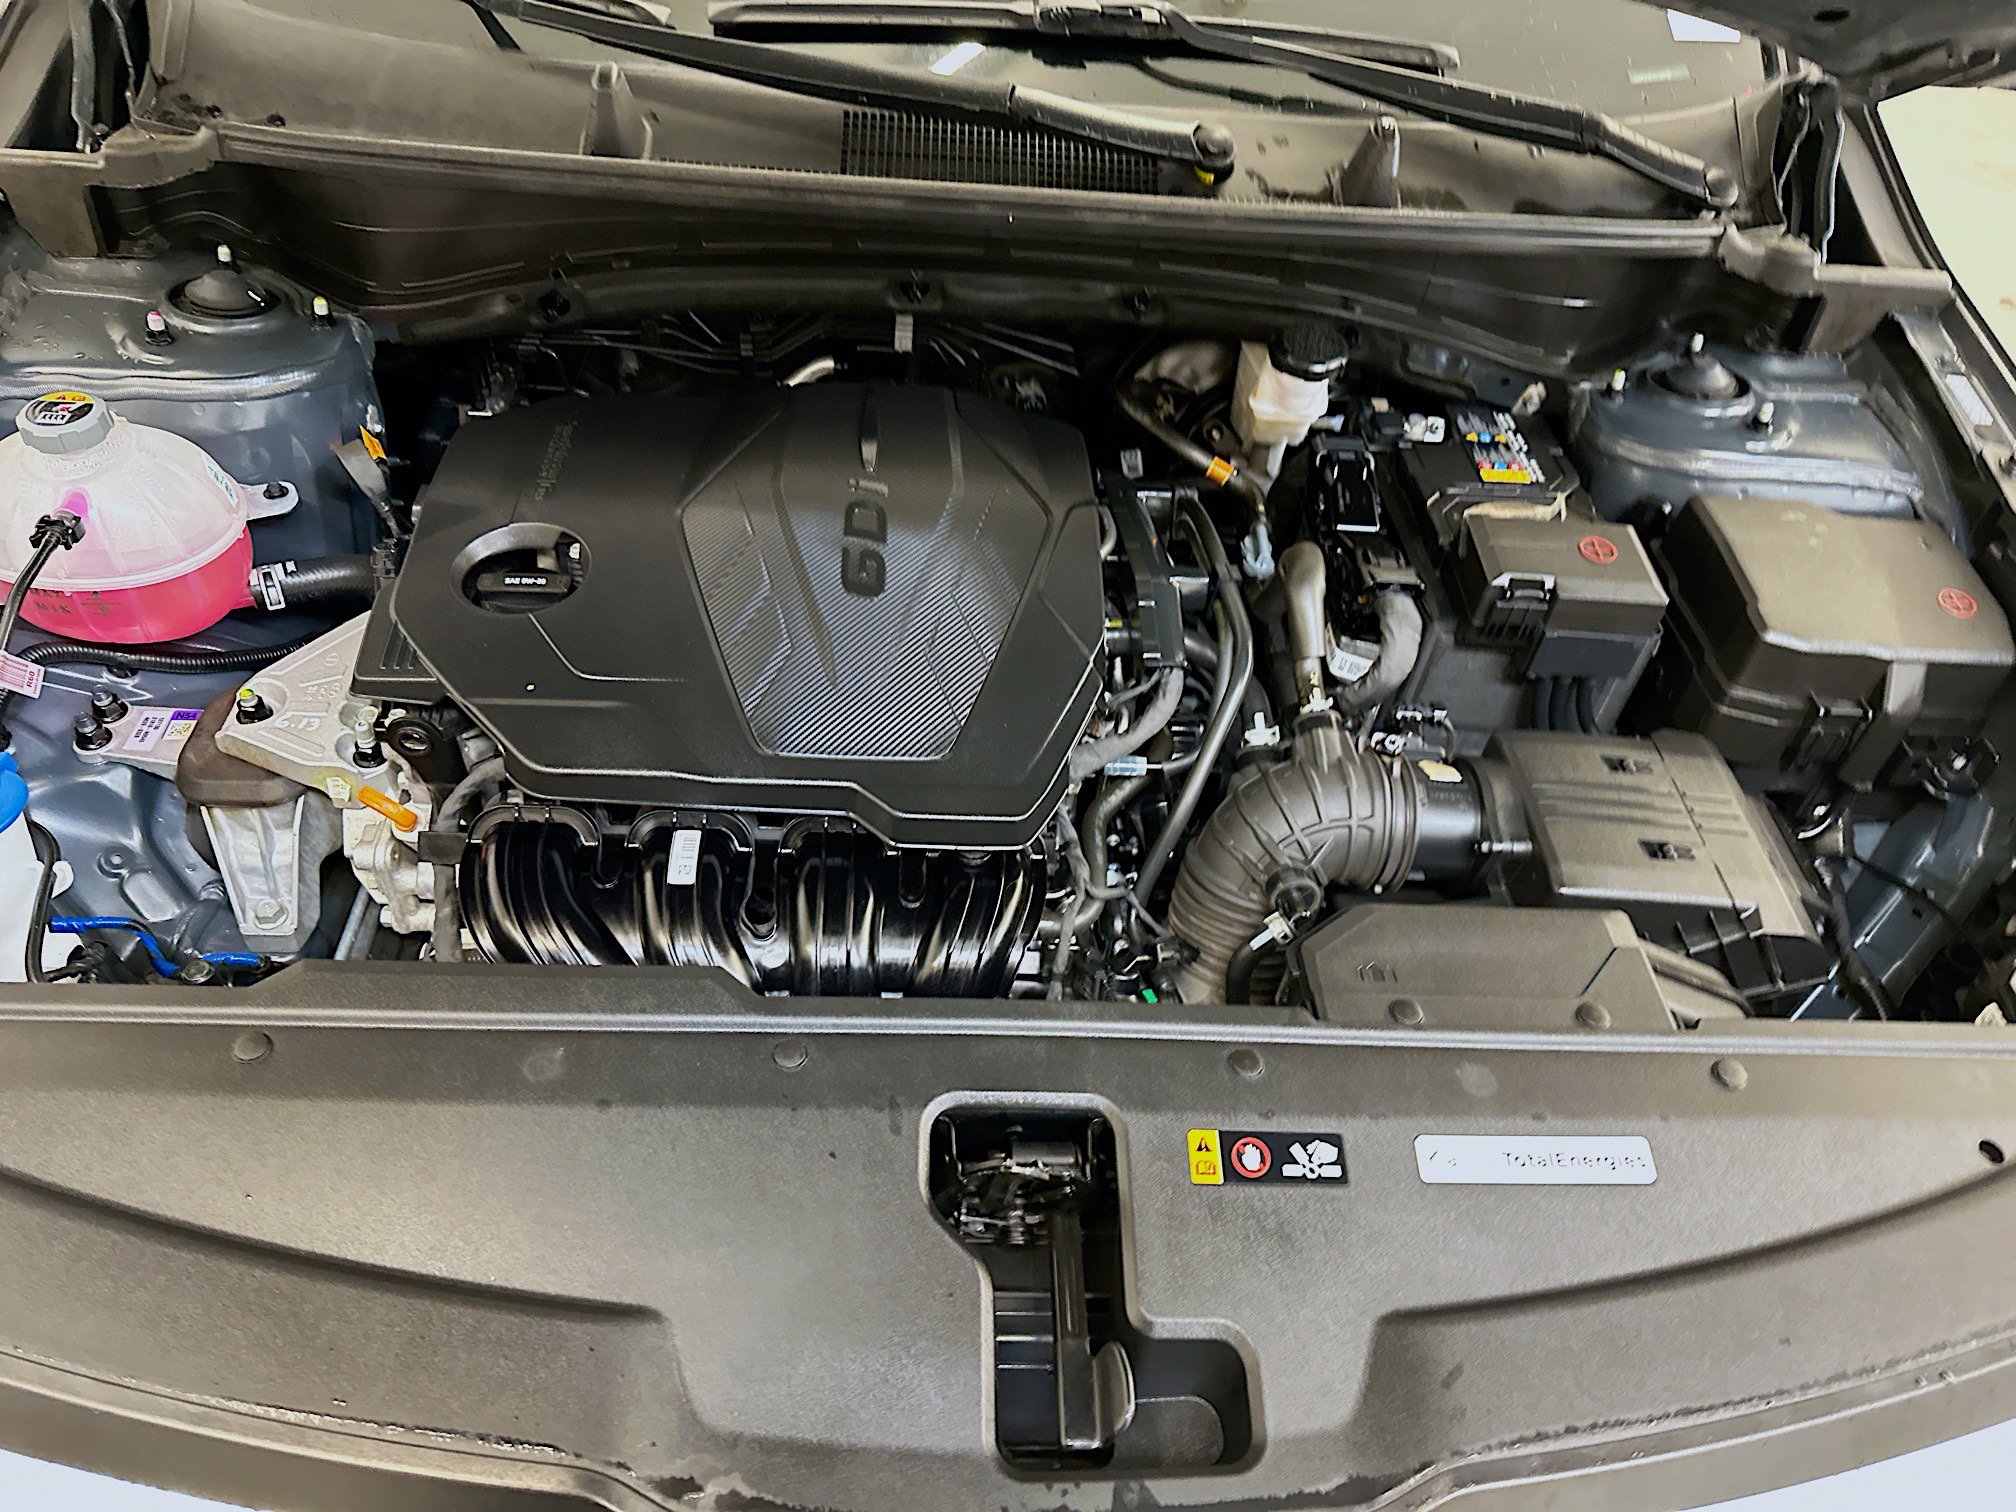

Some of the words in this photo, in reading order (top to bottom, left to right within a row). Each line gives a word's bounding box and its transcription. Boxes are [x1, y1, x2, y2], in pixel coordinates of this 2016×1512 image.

[841, 478, 889, 598] GDi
[26, 671, 36, 688] R60
[175, 711, 198, 719] N54
[274, 714, 320, 731] 6.13
